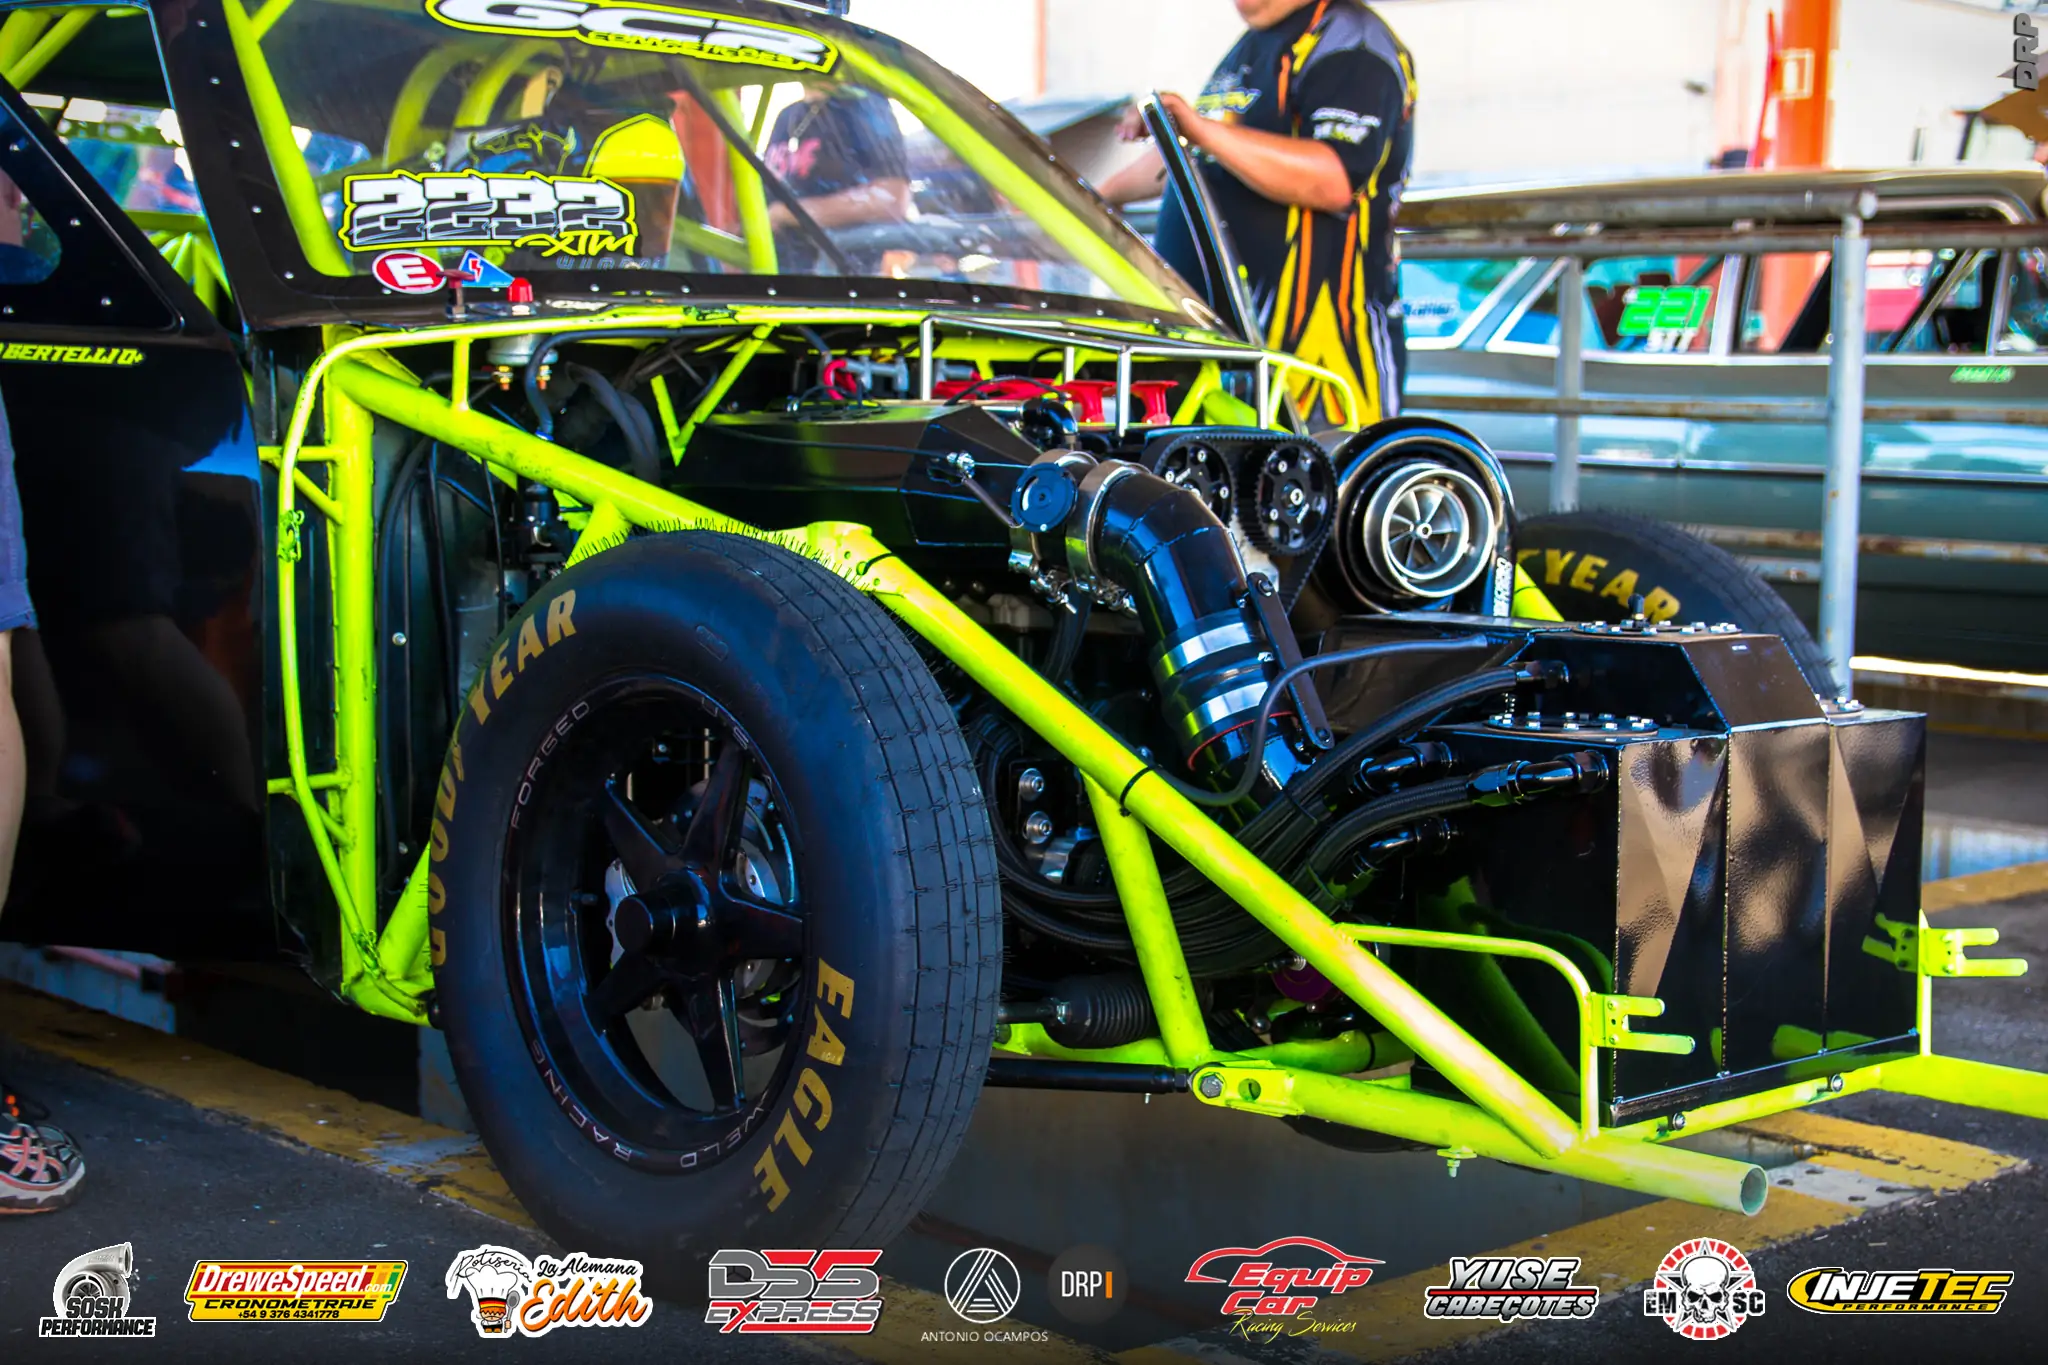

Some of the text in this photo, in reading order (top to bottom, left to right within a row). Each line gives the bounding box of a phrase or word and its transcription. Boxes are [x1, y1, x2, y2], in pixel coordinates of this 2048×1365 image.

[350, 175, 628, 246] 2232
[384, 256, 434, 288] E
[1617, 285, 1713, 336] 221
[510, 701, 590, 830] FORGED
[530, 1039, 769, 1169] WELD RACING
[754, 957, 855, 1214] EAGLE
